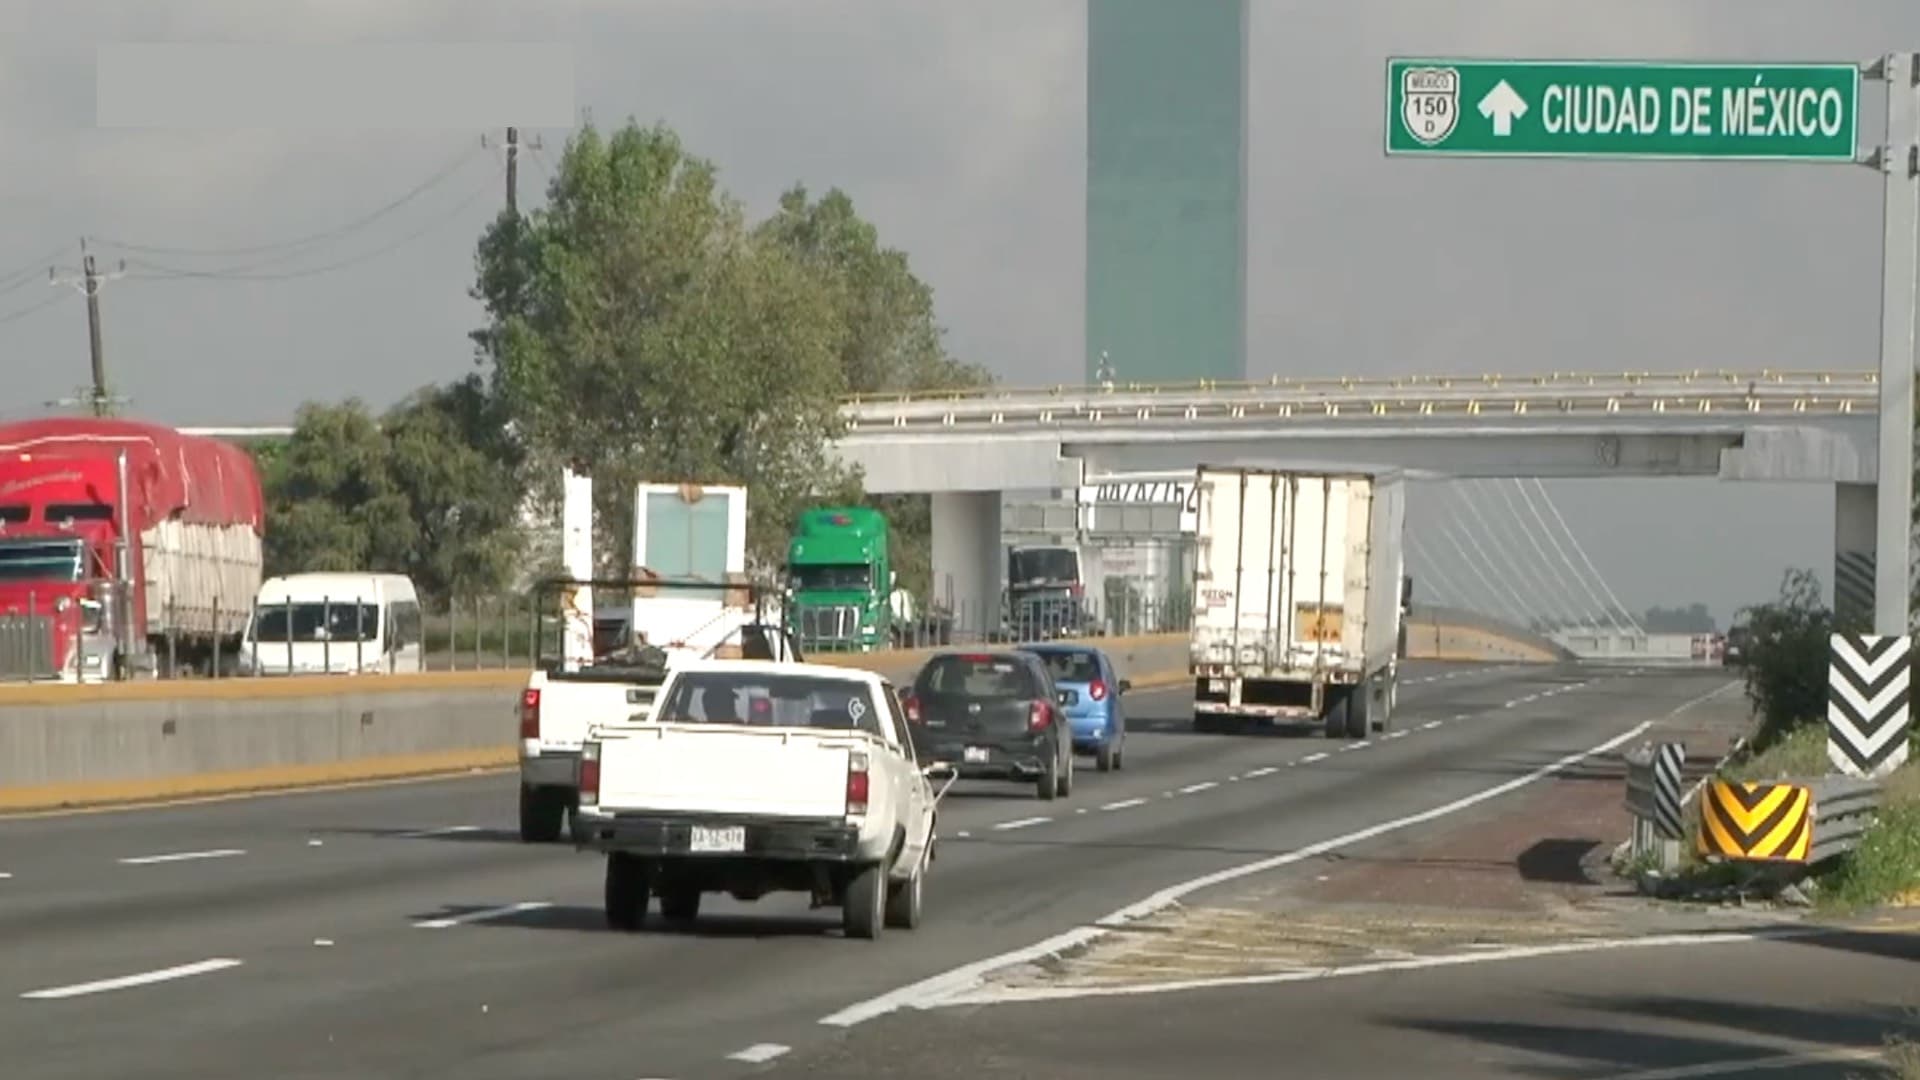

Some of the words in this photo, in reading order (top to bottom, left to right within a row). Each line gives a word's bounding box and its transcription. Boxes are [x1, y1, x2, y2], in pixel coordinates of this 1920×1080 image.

[1413, 97, 1448, 116] 150
[1542, 84, 1661, 134] CIUDAD
[1669, 86, 1712, 135] DE
[1721, 74, 1843, 137] MÉXICO
[1425, 120, 1436, 133] D
